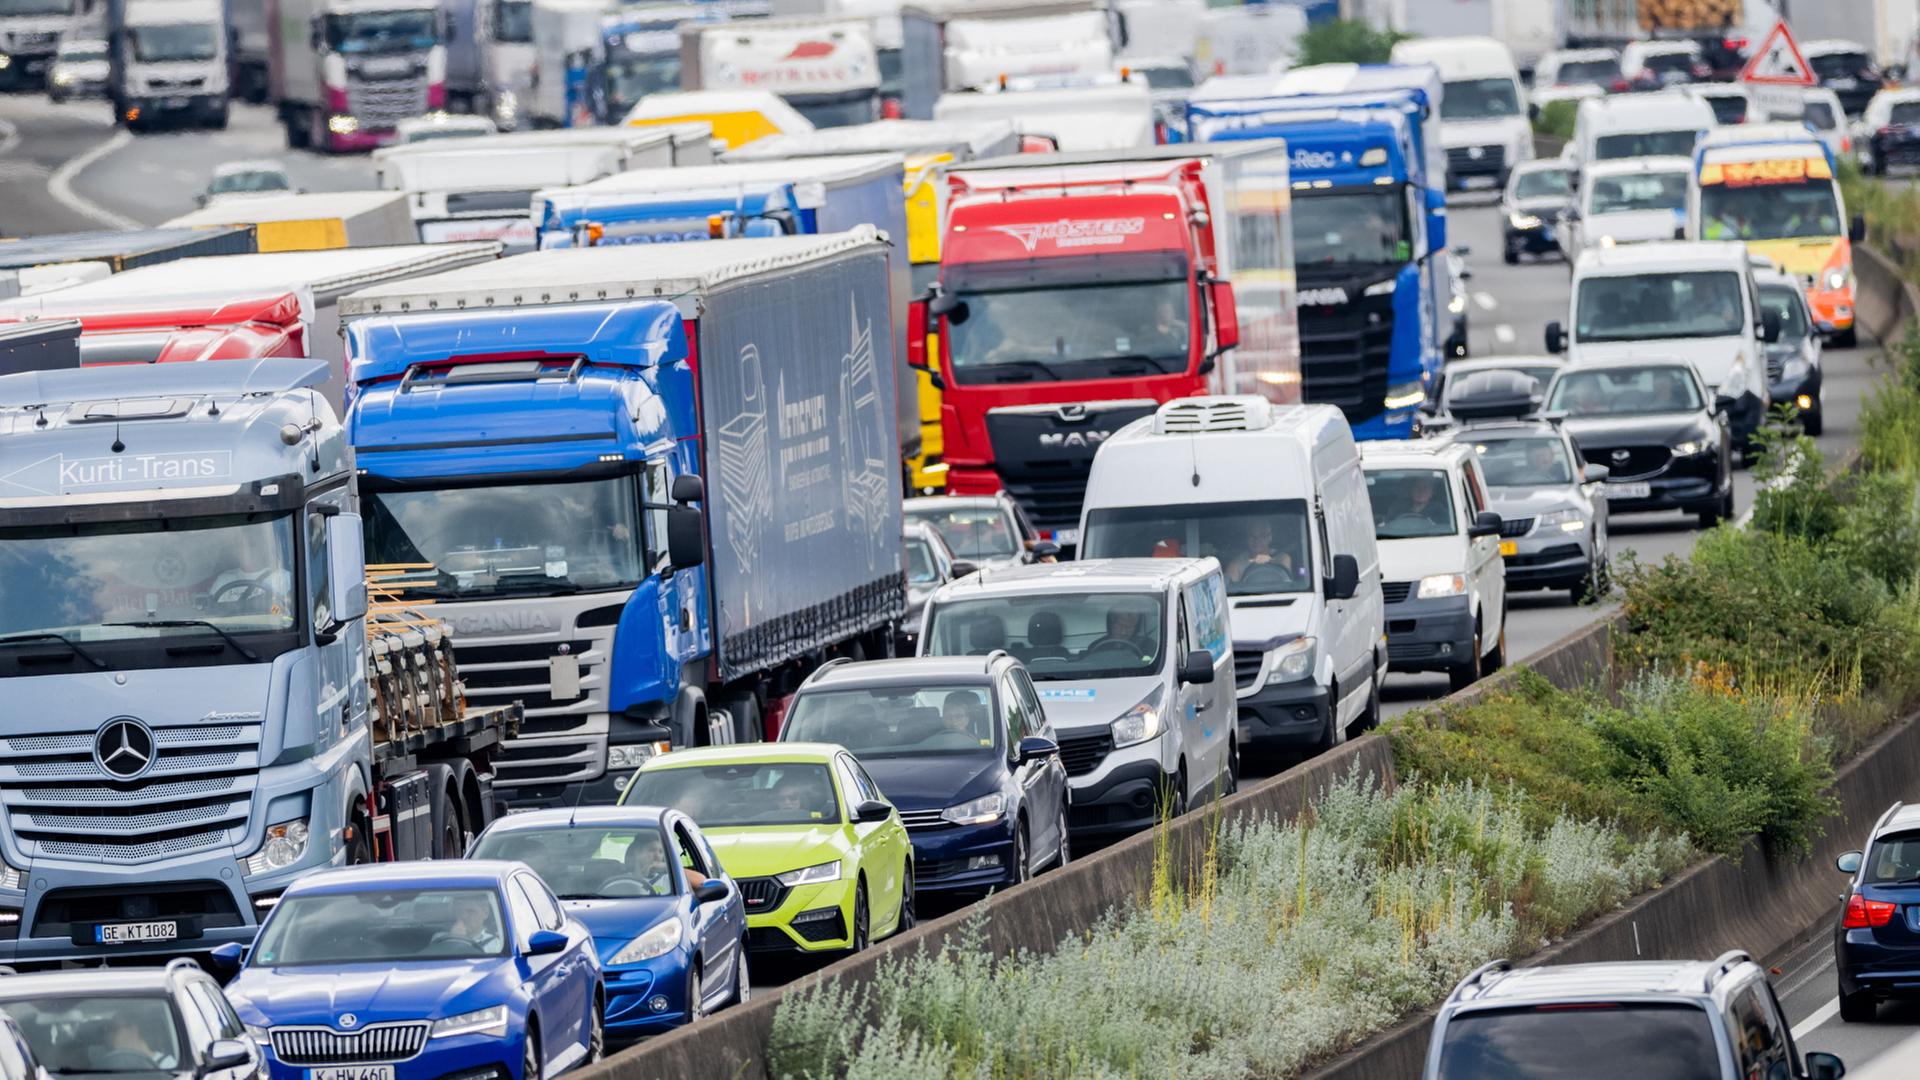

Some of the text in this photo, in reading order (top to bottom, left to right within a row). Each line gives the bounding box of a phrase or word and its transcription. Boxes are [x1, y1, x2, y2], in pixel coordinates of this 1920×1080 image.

[1039, 430, 1111, 449] MAN
[60, 456, 216, 486] Kurti-Trans
[103, 923, 175, 940] GE KT 1082
[316, 1067, 388, 1080] K HW 460
